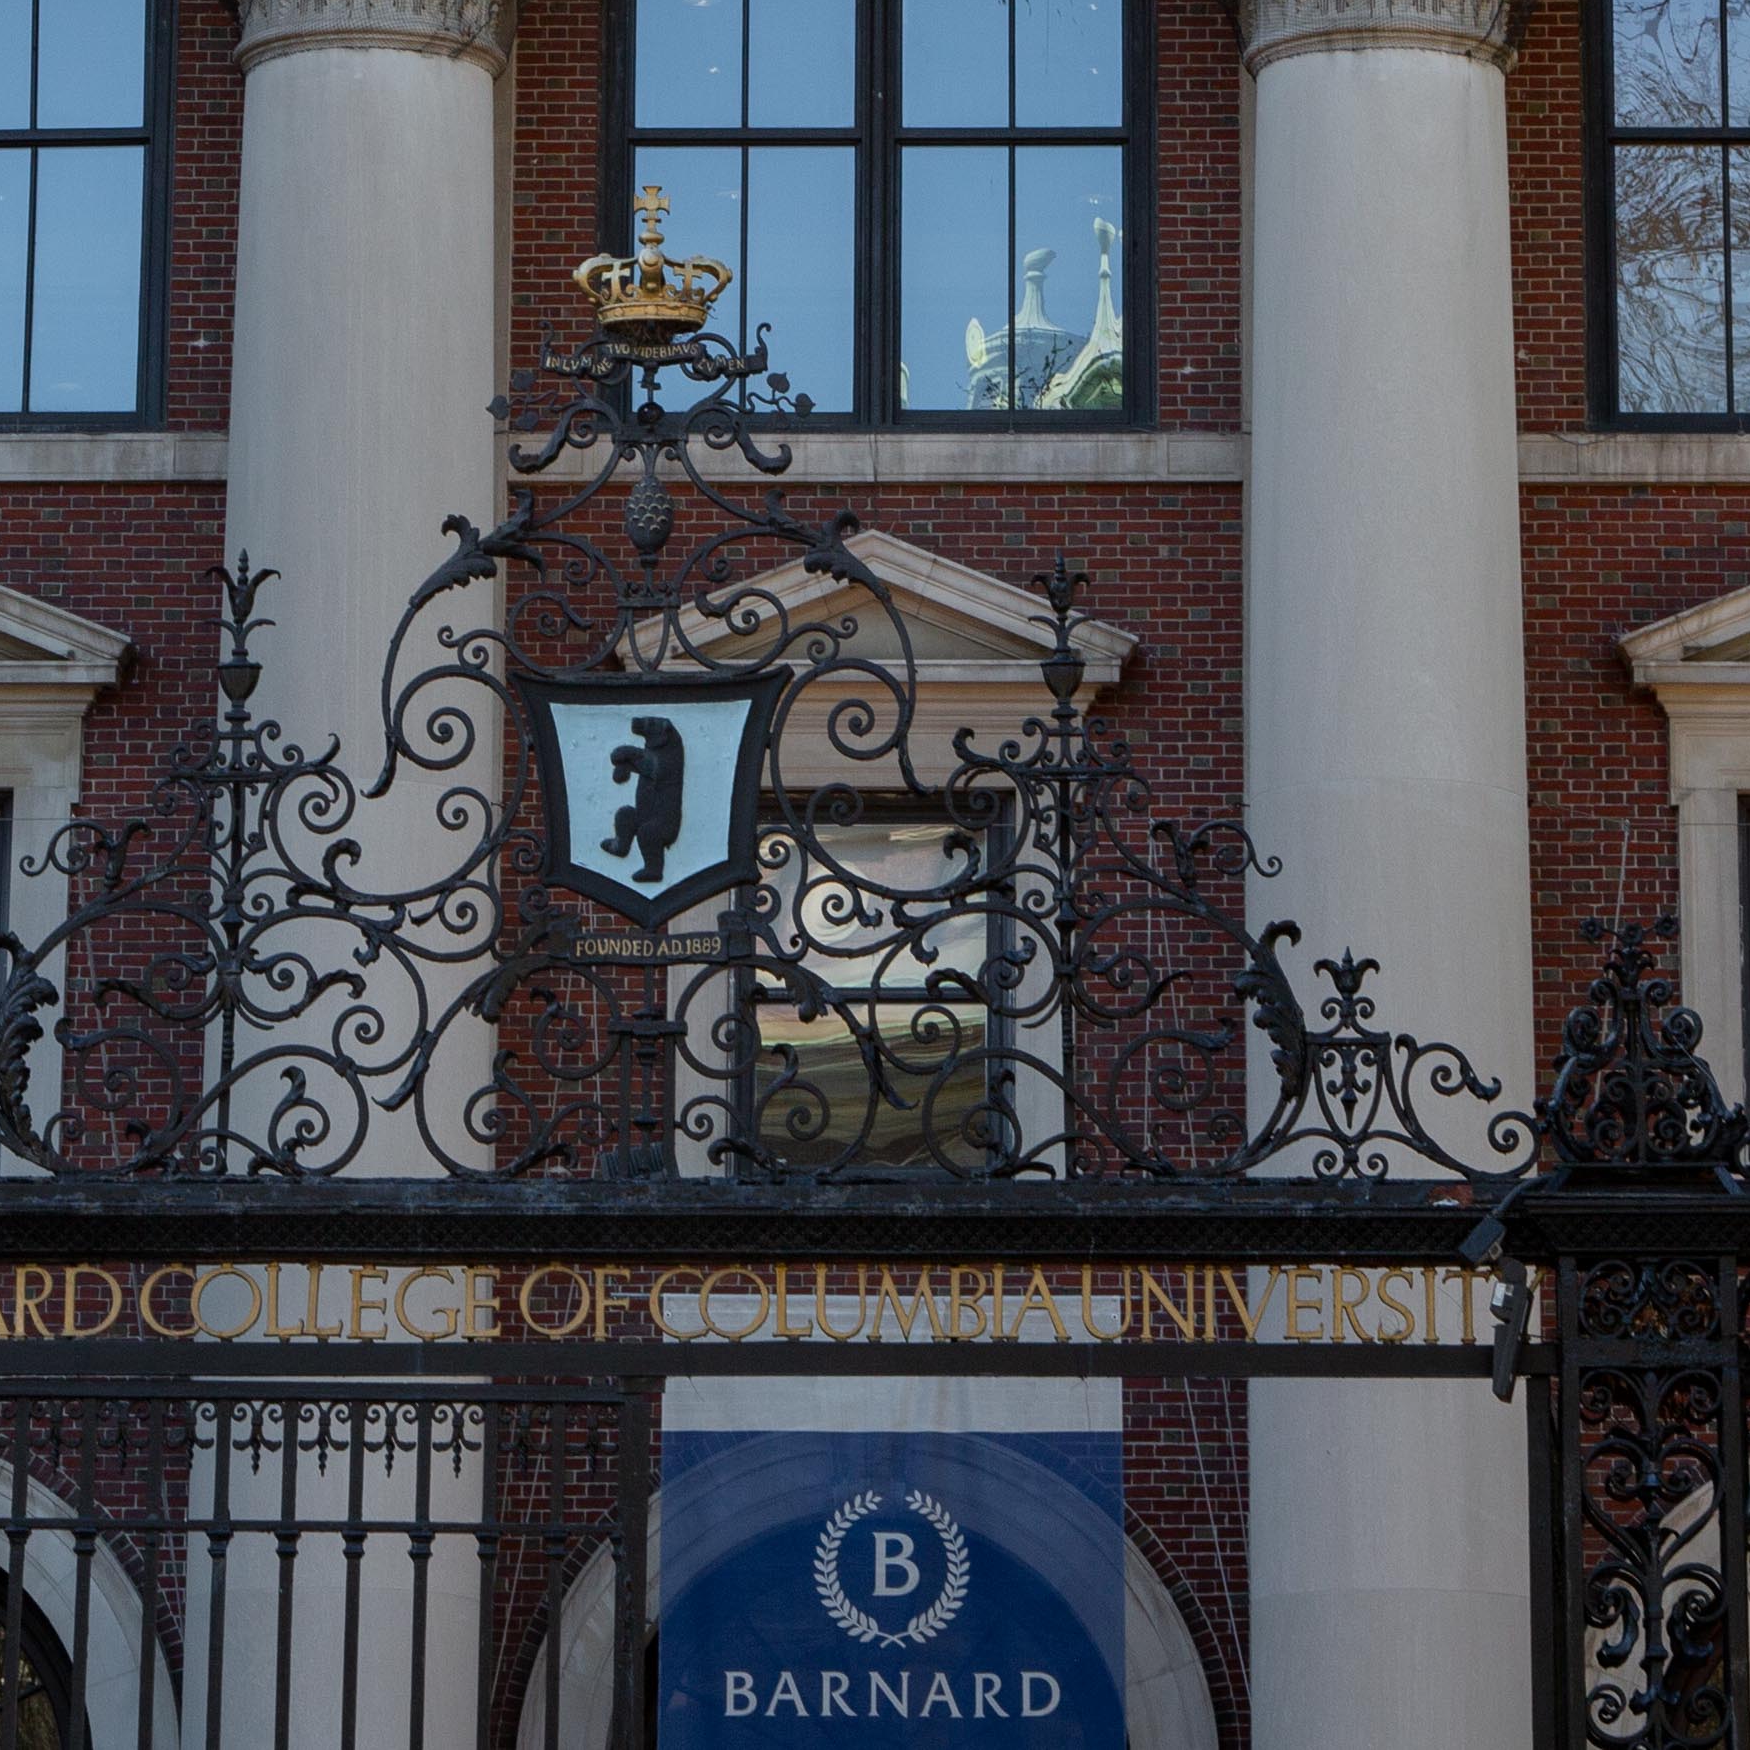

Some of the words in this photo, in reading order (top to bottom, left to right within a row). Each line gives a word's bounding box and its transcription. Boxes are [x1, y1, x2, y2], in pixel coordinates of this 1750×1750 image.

[575, 939, 654, 957] FOUNDED
[139, 1260, 501, 1341] COLLEGE
[520, 1260, 631, 1341] OF
[650, 1261, 1071, 1342] COLUMBIA
[871, 1531, 921, 1597] B
[723, 1670, 1061, 1719] BARNARD
